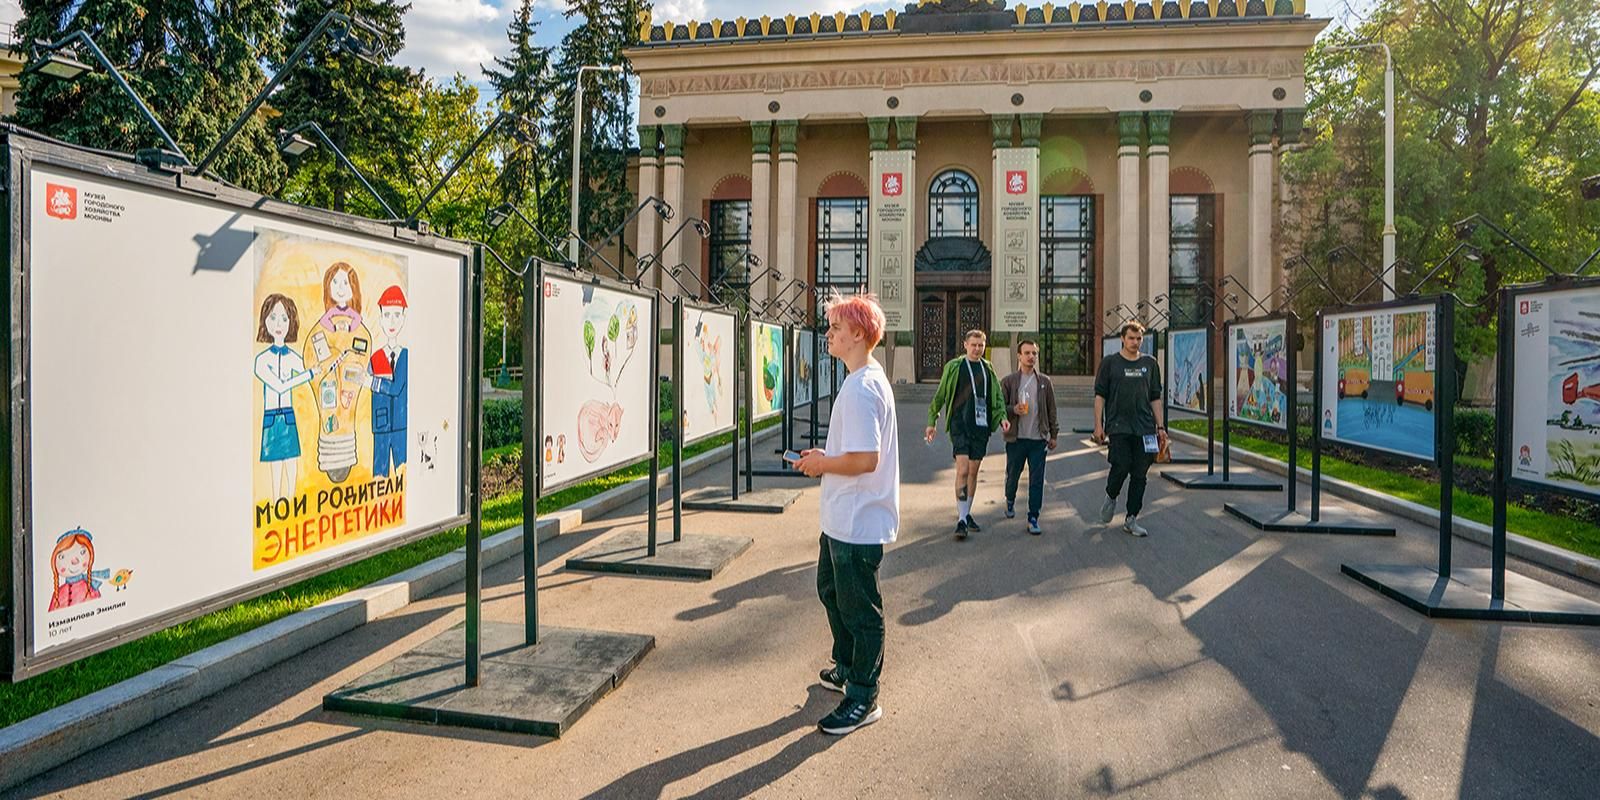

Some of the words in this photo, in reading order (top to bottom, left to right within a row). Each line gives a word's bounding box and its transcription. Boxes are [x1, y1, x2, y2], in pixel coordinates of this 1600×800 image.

[84, 192, 106, 200] МУЗЕЙ
[84, 199, 125, 211] ГОРОДСКОГО
[84, 206, 121, 217] ХОЗЯЙСТВА
[84, 214, 112, 223] МОСКВЫ
[256, 493, 307, 528] МОИ
[317, 474, 404, 513] РОДИТЕЛИ
[261, 495, 403, 563] ЭНЕРГЕТИКИ
[48, 610, 95, 629] Измаилова
[96, 601, 126, 615] Эмилия
[48, 630, 57, 638] 10
[59, 626, 73, 636] лет
